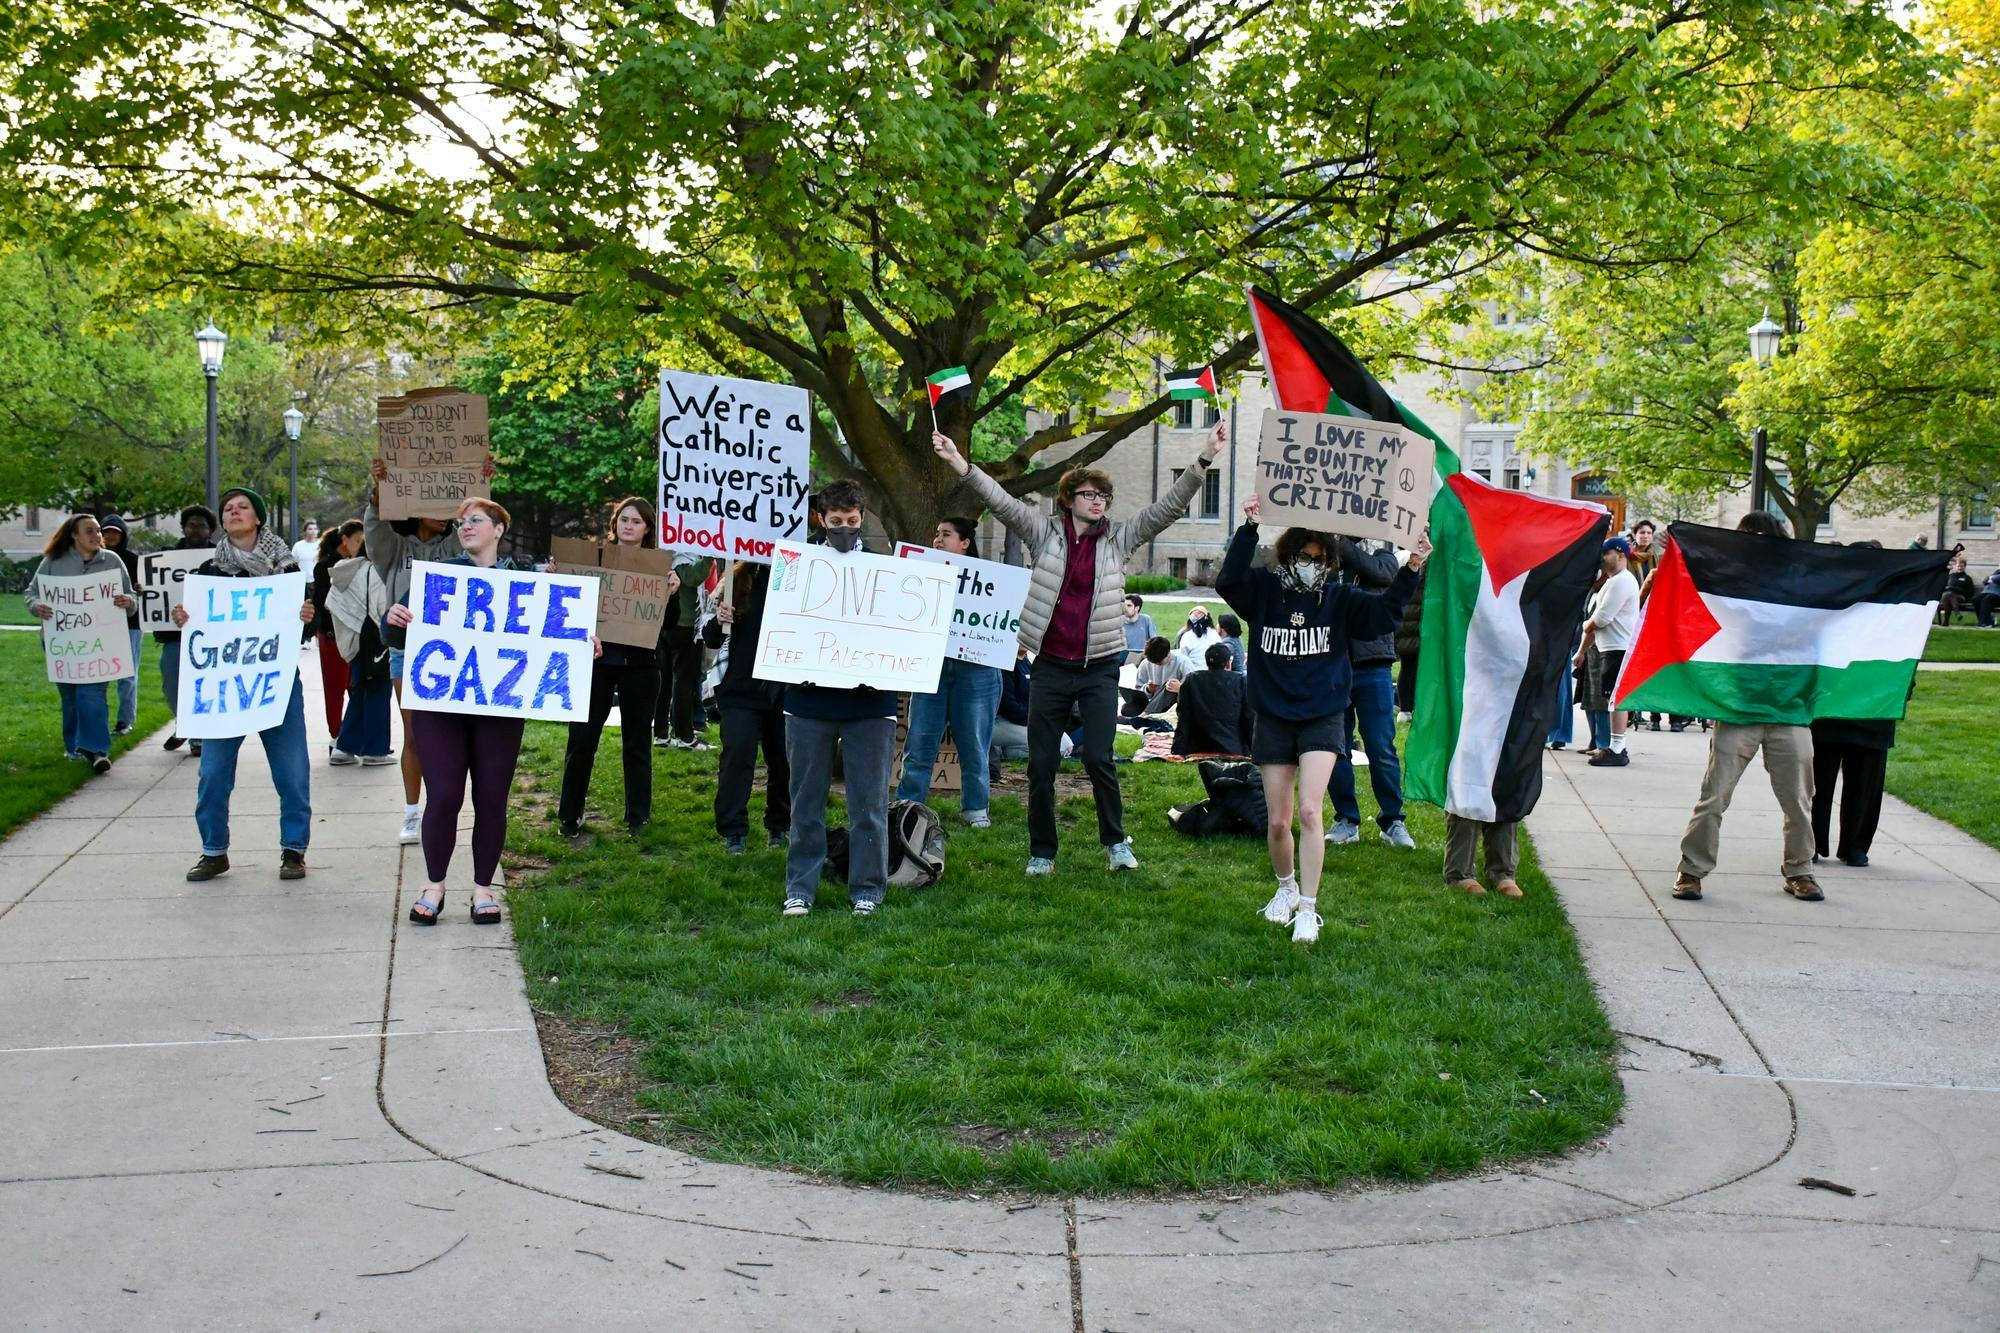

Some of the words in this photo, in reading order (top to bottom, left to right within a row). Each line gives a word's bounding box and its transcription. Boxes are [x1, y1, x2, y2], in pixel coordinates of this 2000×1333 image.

[410, 404, 432, 420] YOU
[666, 380, 771, 429] We're
[785, 414, 805, 433] a
[379, 421, 414, 434] NEED
[418, 422, 433, 433] TO
[436, 421, 455, 433] BE
[380, 436, 435, 450] MUSLIM
[443, 436, 458, 449] TO
[461, 434, 487, 447] CARE
[662, 415, 782, 464] Catholic
[1276, 417, 1298, 443] I
[1315, 422, 1366, 449] LOVE
[1379, 436, 1408, 458] MY
[386, 452, 397, 466] 4
[418, 451, 453, 468] GAZA
[1283, 444, 1388, 476] COUNTRY
[396, 485, 413, 497] BE
[420, 484, 467, 499] HUMAN
[409, 471, 438, 484] JUST
[442, 471, 476, 485] NEED
[662, 451, 809, 511] University
[1261, 461, 1317, 484] THATS
[1322, 469, 1366, 492] WHY
[1370, 478, 1386, 498] I
[770, 498, 804, 538] by
[1268, 483, 1390, 522] CRITIQUE
[1394, 504, 1416, 536] IT
[662, 511, 727, 552] blood
[43, 584, 95, 605] WHILE
[99, 582, 119, 599] WE
[623, 575, 661, 598] DAME
[800, 559, 951, 627] DIVEST
[957, 568, 995, 597] the
[56, 610, 92, 631] READ
[208, 587, 273, 622] LET
[422, 571, 589, 642] FREE
[634, 600, 663, 621] NOW
[50, 638, 104, 656] GAZA
[189, 630, 280, 670] Gaza
[763, 631, 803, 663] FREE
[1299, 626, 1331, 655] DAME
[55, 658, 121, 680] BLEEDS
[410, 638, 573, 711] GAZA
[192, 671, 280, 714] LIVE
